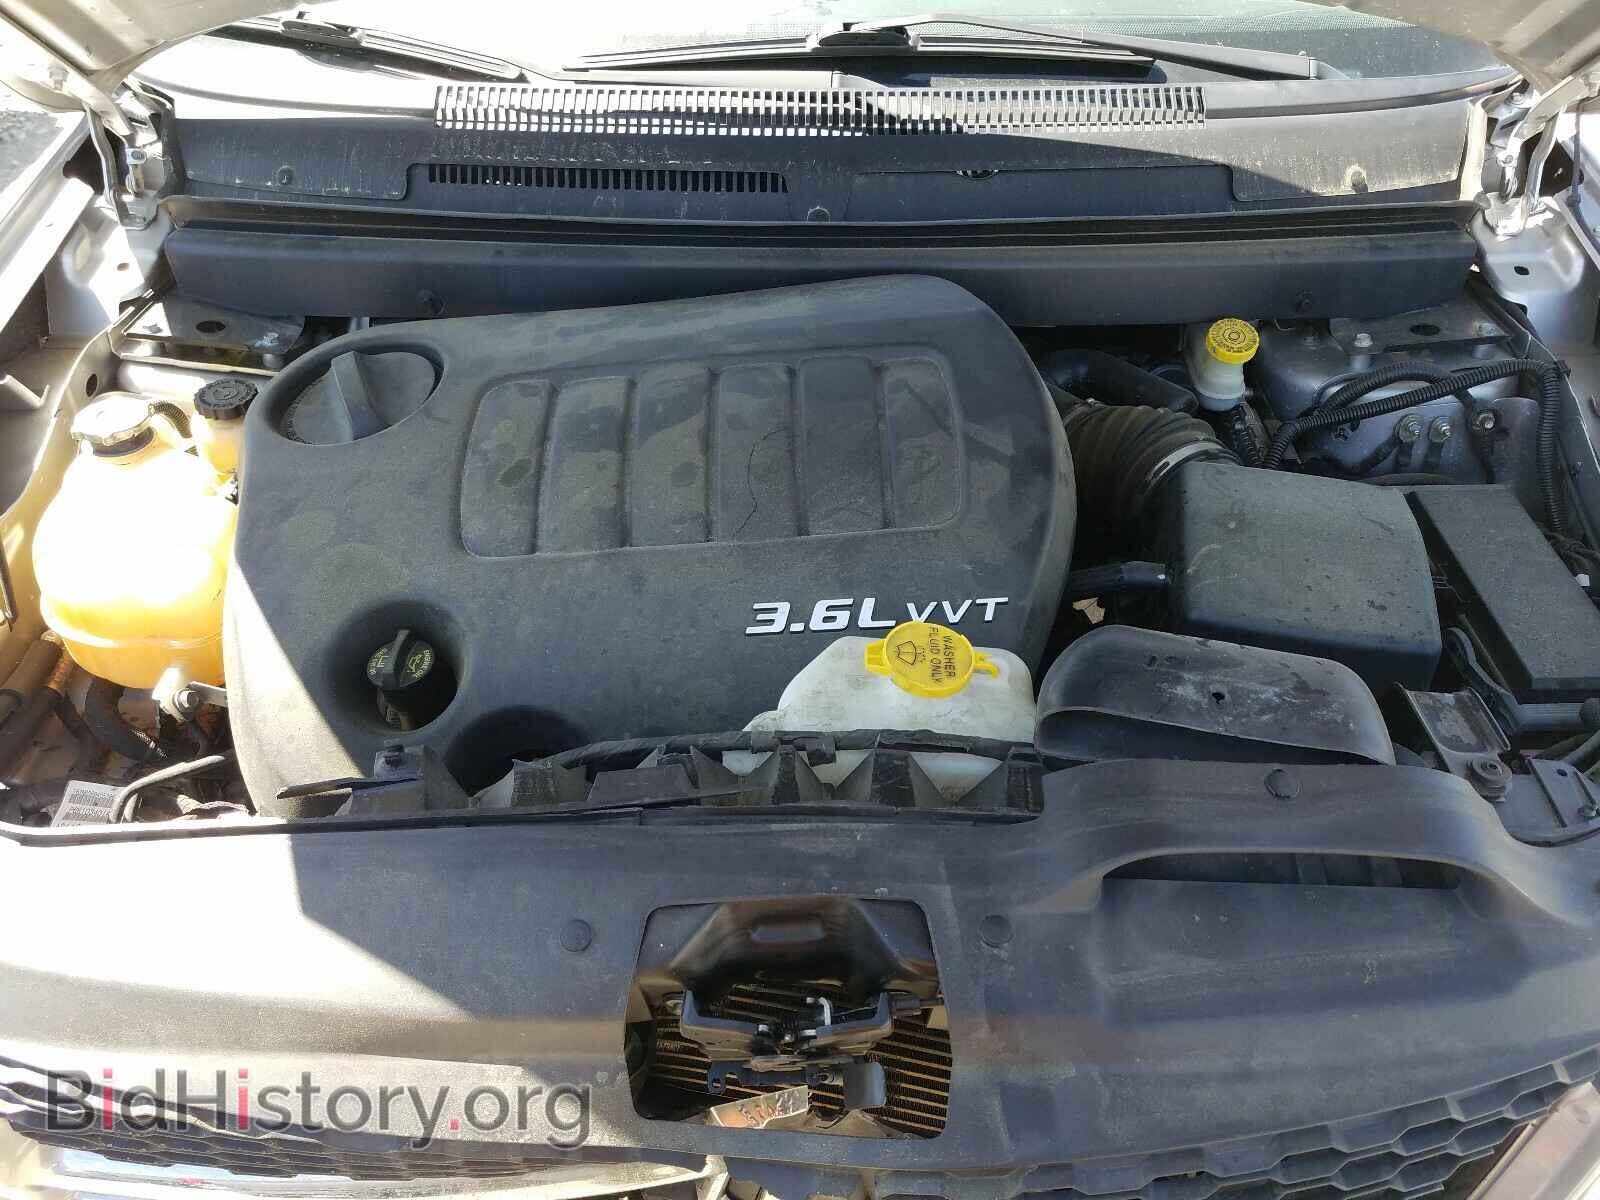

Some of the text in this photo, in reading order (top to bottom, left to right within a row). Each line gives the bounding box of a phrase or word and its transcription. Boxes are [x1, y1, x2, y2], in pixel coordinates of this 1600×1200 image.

[745, 597, 1009, 634] 3.6L VVT
[928, 626, 943, 683] FLUID ONLY
[942, 635, 957, 679] WASHER
